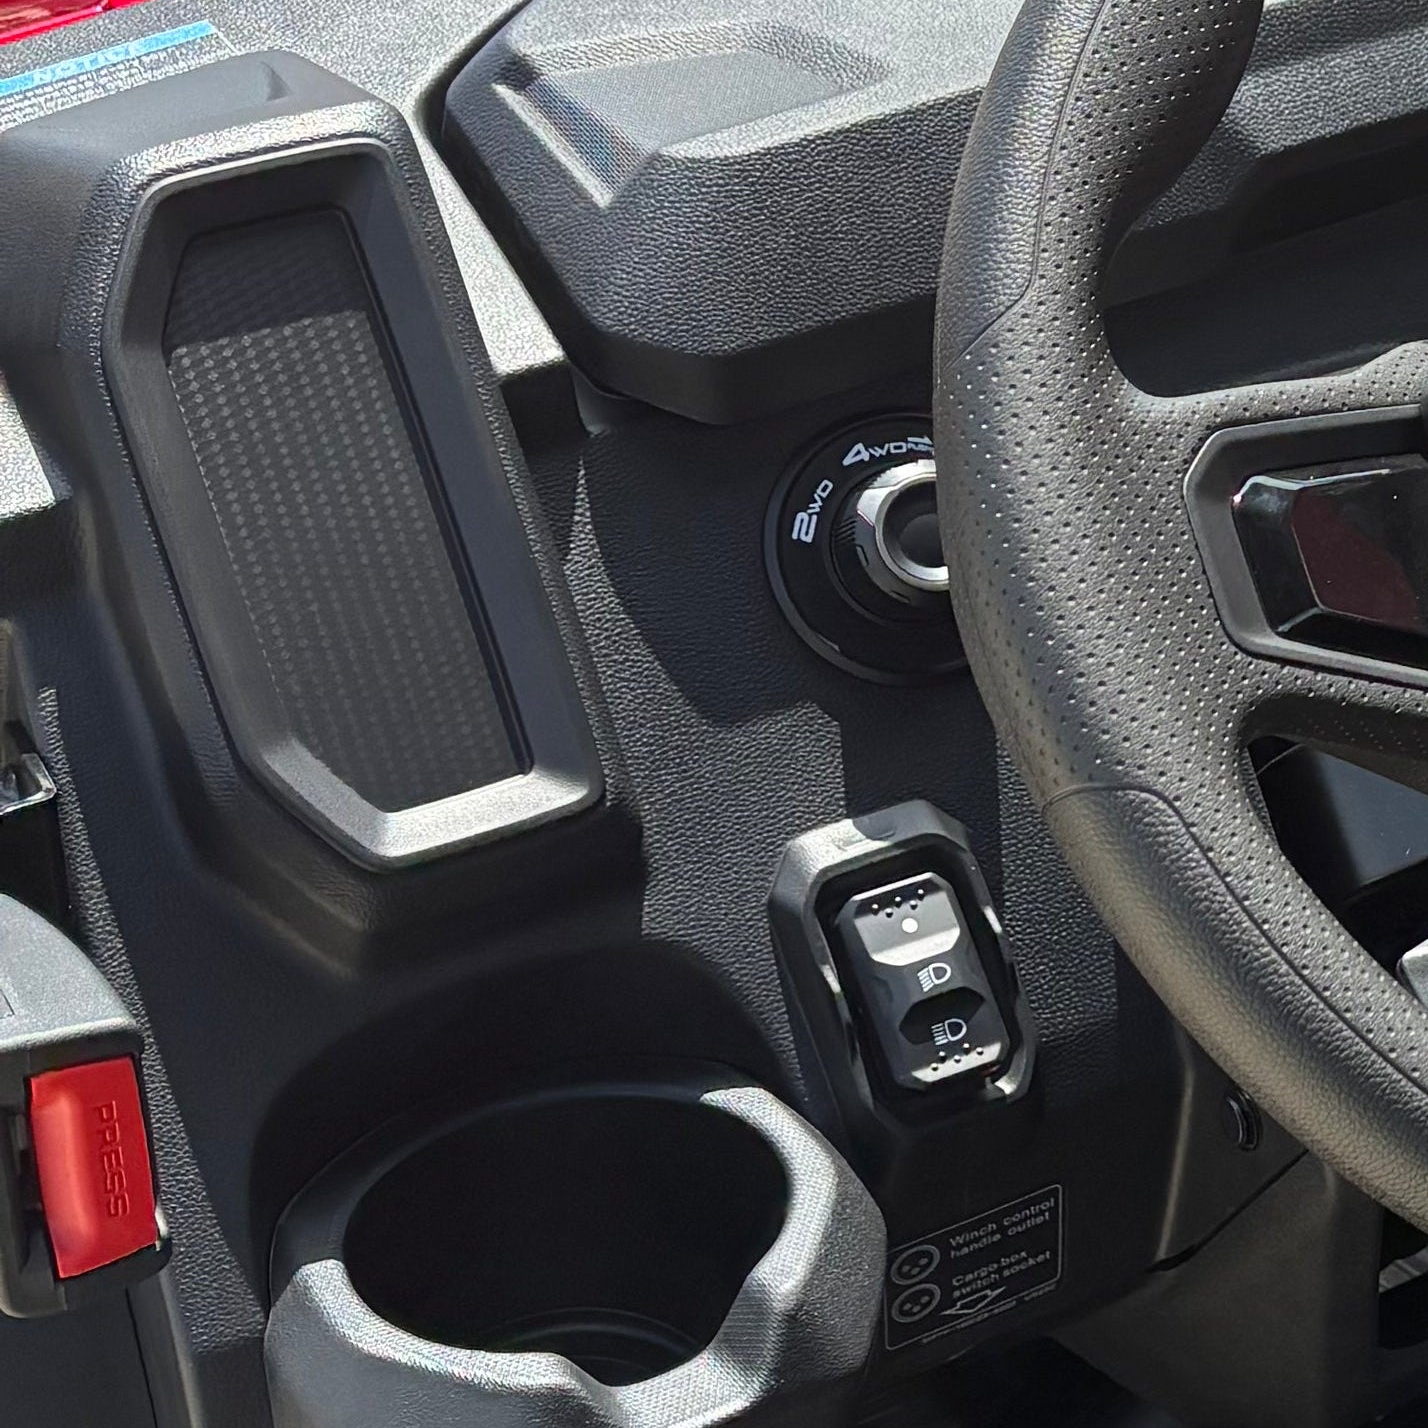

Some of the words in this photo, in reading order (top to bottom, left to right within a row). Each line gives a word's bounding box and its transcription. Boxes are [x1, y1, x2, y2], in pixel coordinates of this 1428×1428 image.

[842, 442, 907, 467] 4WD
[791, 479, 834, 543] 2WD
[95, 1099, 131, 1218] PRESS
[949, 1222, 998, 1248] Winch
[1003, 1197, 1056, 1226] control
[950, 1233, 1002, 1260] handle
[1007, 1212, 1050, 1237] outlet
[951, 1262, 998, 1287] Cargo
[1000, 1250, 1029, 1268] box
[952, 1273, 1001, 1300] switch
[1003, 1251, 1052, 1278] socket
